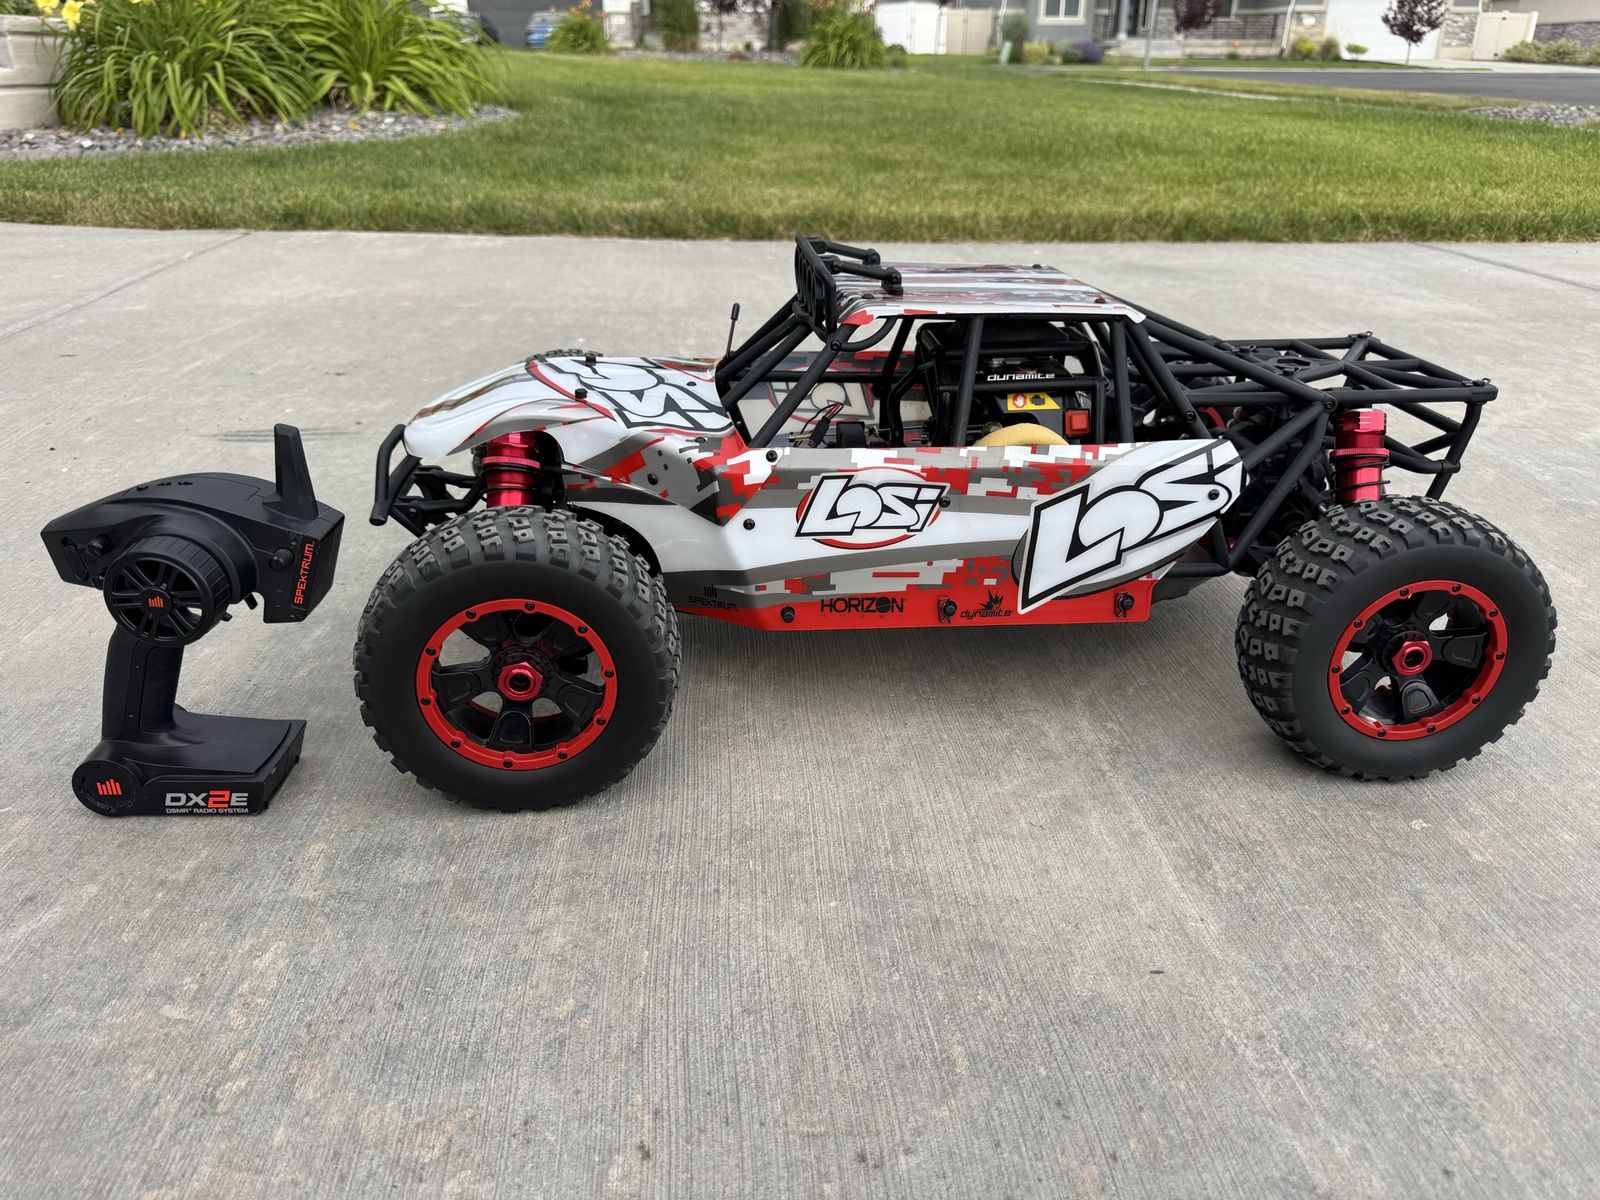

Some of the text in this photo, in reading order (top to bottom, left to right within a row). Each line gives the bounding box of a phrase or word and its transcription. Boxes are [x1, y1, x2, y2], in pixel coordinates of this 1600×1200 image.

[294, 543, 315, 605] SPEKTRUM
[820, 597, 904, 613] HORIZON
[960, 609, 1012, 620] dynamite
[165, 790, 249, 808] DX2E
